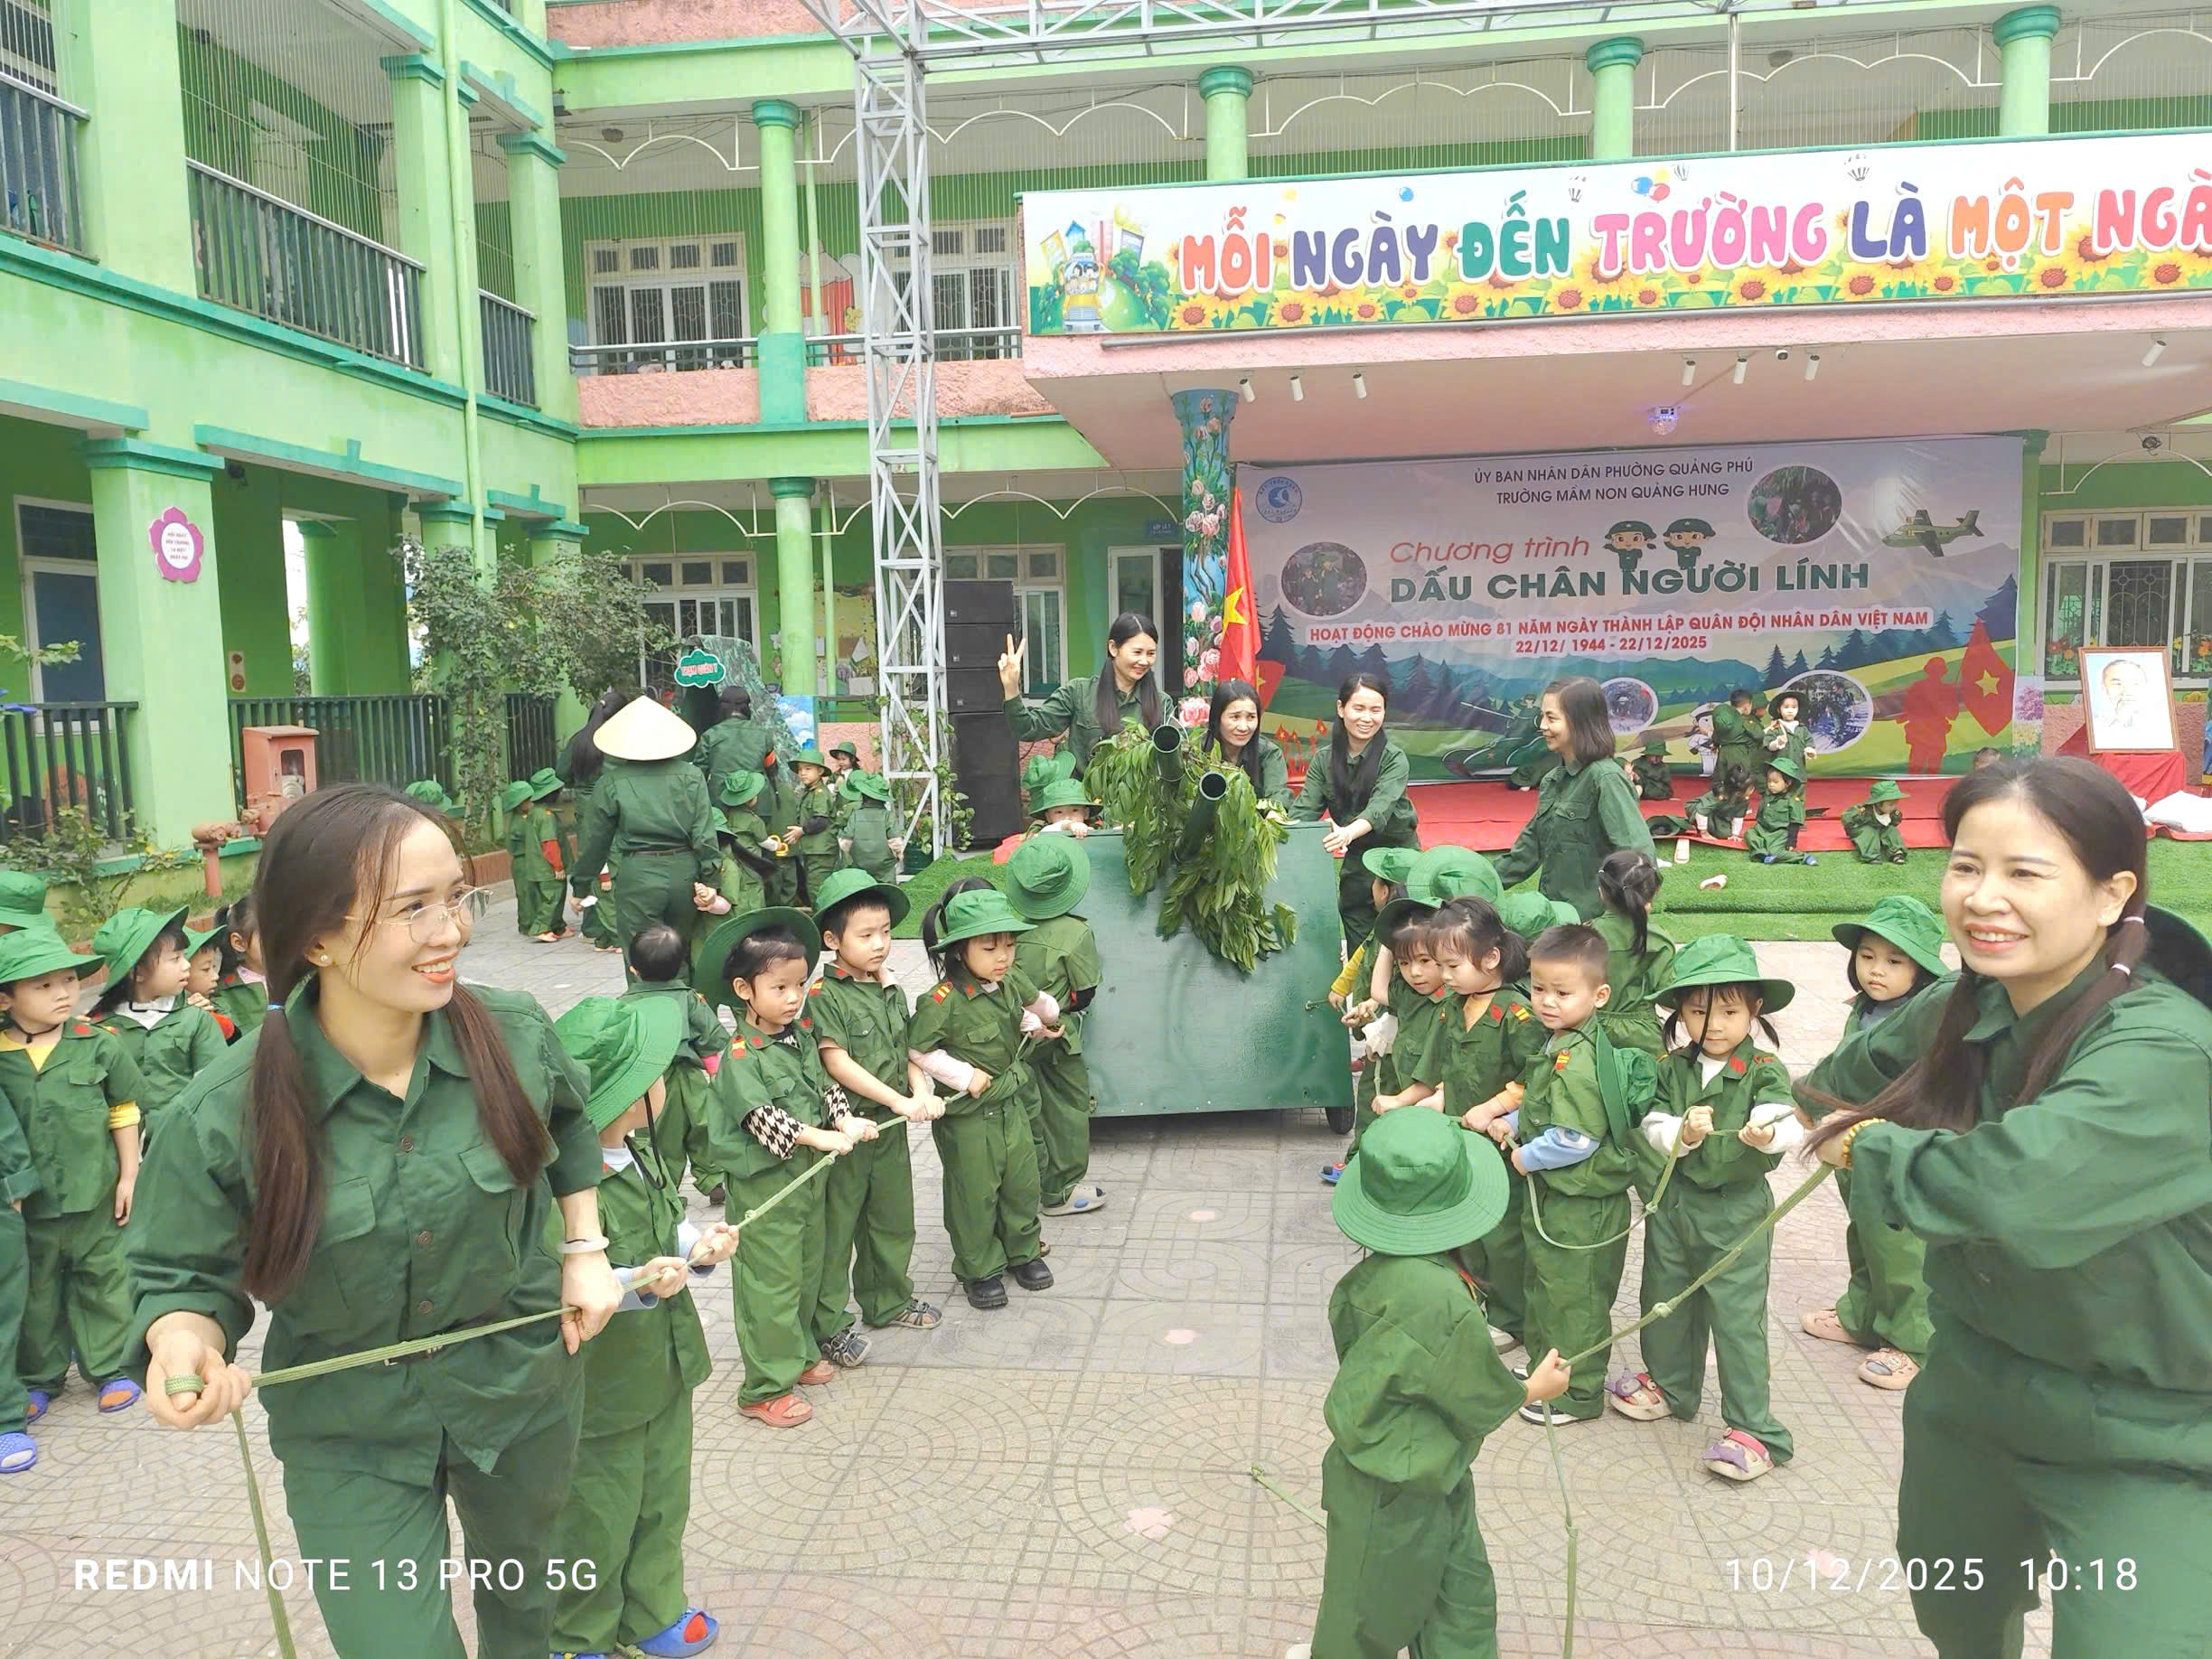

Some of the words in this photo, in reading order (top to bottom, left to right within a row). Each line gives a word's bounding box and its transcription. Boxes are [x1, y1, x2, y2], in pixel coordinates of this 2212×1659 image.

[1183, 207, 1270, 292] MỖI
[1293, 211, 1439, 286] NGÀY
[1457, 191, 1570, 276] ĐẾN
[1594, 191, 1827, 272] TRƯỜNG
[1852, 181, 1926, 258] LÀ
[1952, 177, 2074, 269] MỘT
[2096, 168, 2212, 248] NGÀ
[1474, 468, 1491, 483] ỦY
[1495, 471, 1523, 483] BAN
[1528, 466, 1567, 481] NHÂN
[1571, 464, 1600, 479] DÂN
[1605, 462, 1664, 478] PHƯỜNG
[1669, 458, 1722, 475] QUẢNG
[1727, 456, 1753, 473] PHÚ
[1496, 488, 1552, 504] TRƯỜNG
[1556, 484, 1590, 501] MẦM
[1596, 487, 1626, 500] NON
[1631, 482, 1684, 499] QUẢNG
[1390, 541, 1514, 564] Chương
[1525, 535, 1590, 558] trình
[1391, 565, 1472, 603] DẤU
[1487, 565, 1606, 599] CHÂN
[1622, 559, 1759, 595] NGƯỜI
[1776, 557, 1869, 591] LÍNH
[1310, 627, 1349, 643] HOẠT
[1352, 623, 1396, 642] ĐỘNG
[1401, 622, 1443, 638] CHÀO
[1448, 621, 1492, 637] MỪNG
[1496, 622, 1512, 635] 81
[1518, 618, 1551, 634] NĂM
[1556, 616, 1598, 633] NGÀY
[1603, 616, 1652, 633] THÀNH
[1657, 614, 1684, 634] LẬP
[1689, 613, 1733, 630] QUÂN
[1738, 613, 1766, 633] ĐỘI
[1771, 611, 1814, 628] NHÂN
[1820, 610, 1851, 626] DÂN
[1857, 609, 1889, 630] VIỆT
[1893, 612, 1928, 625] NAM
[1572, 637, 1607, 651] 1944
[1619, 635, 1707, 651] 22/12/2025
